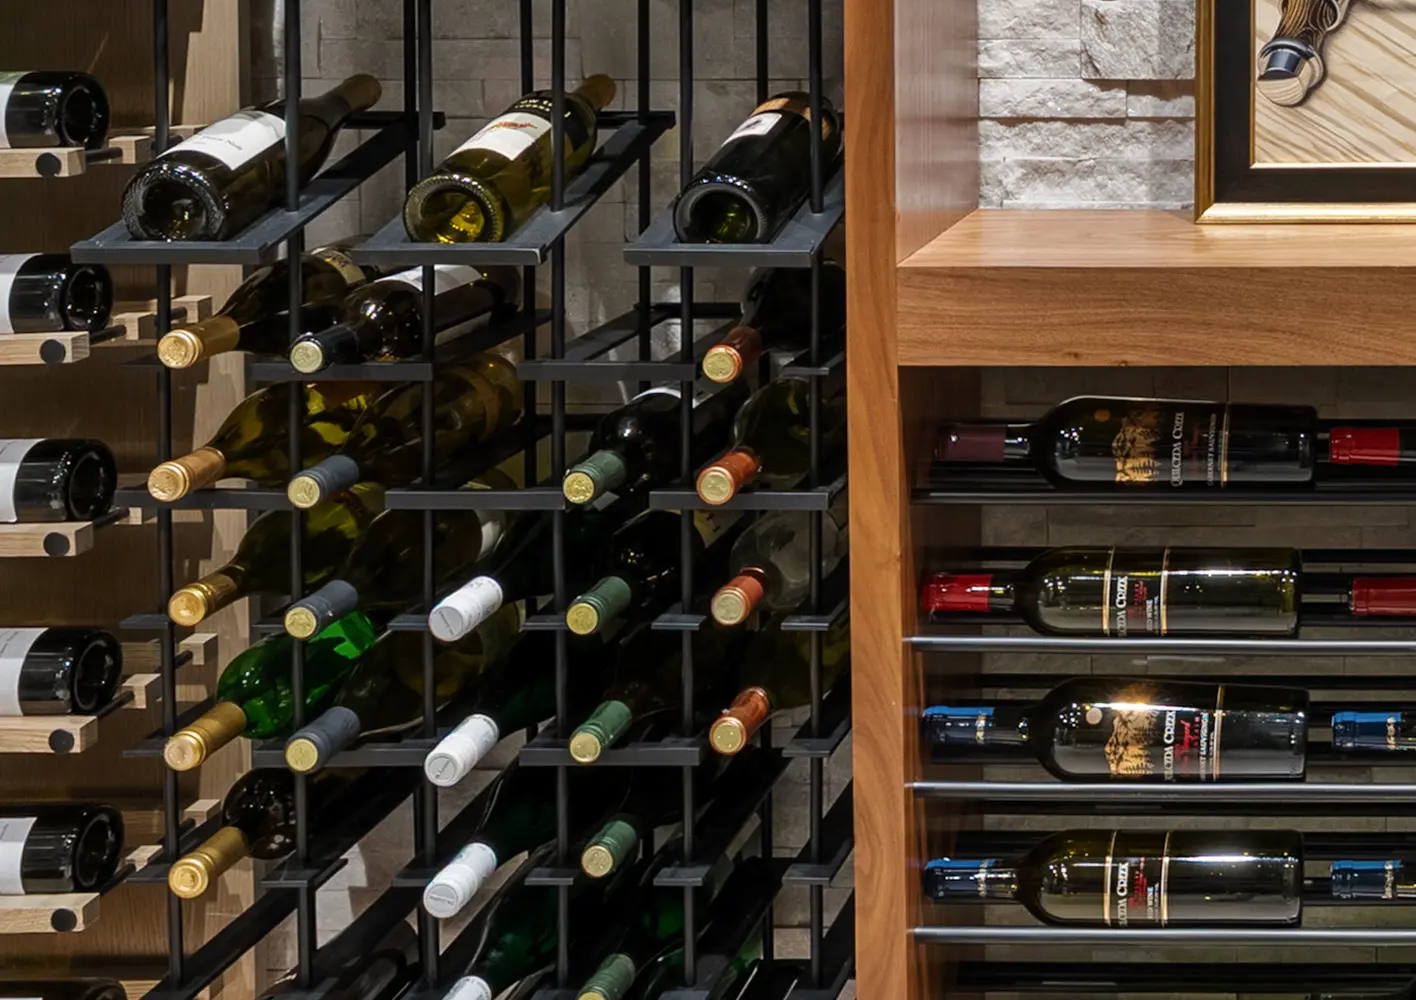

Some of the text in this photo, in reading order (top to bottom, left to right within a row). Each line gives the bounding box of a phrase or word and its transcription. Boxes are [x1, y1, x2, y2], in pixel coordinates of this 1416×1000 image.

[1171, 411, 1185, 487] QUILCEDA CREEK
[1116, 575, 1128, 609] CREEK
[1163, 710, 1176, 744] CREEK
[1200, 712, 1209, 755] SAUVIGNON
[1116, 862, 1129, 897] CREEK
